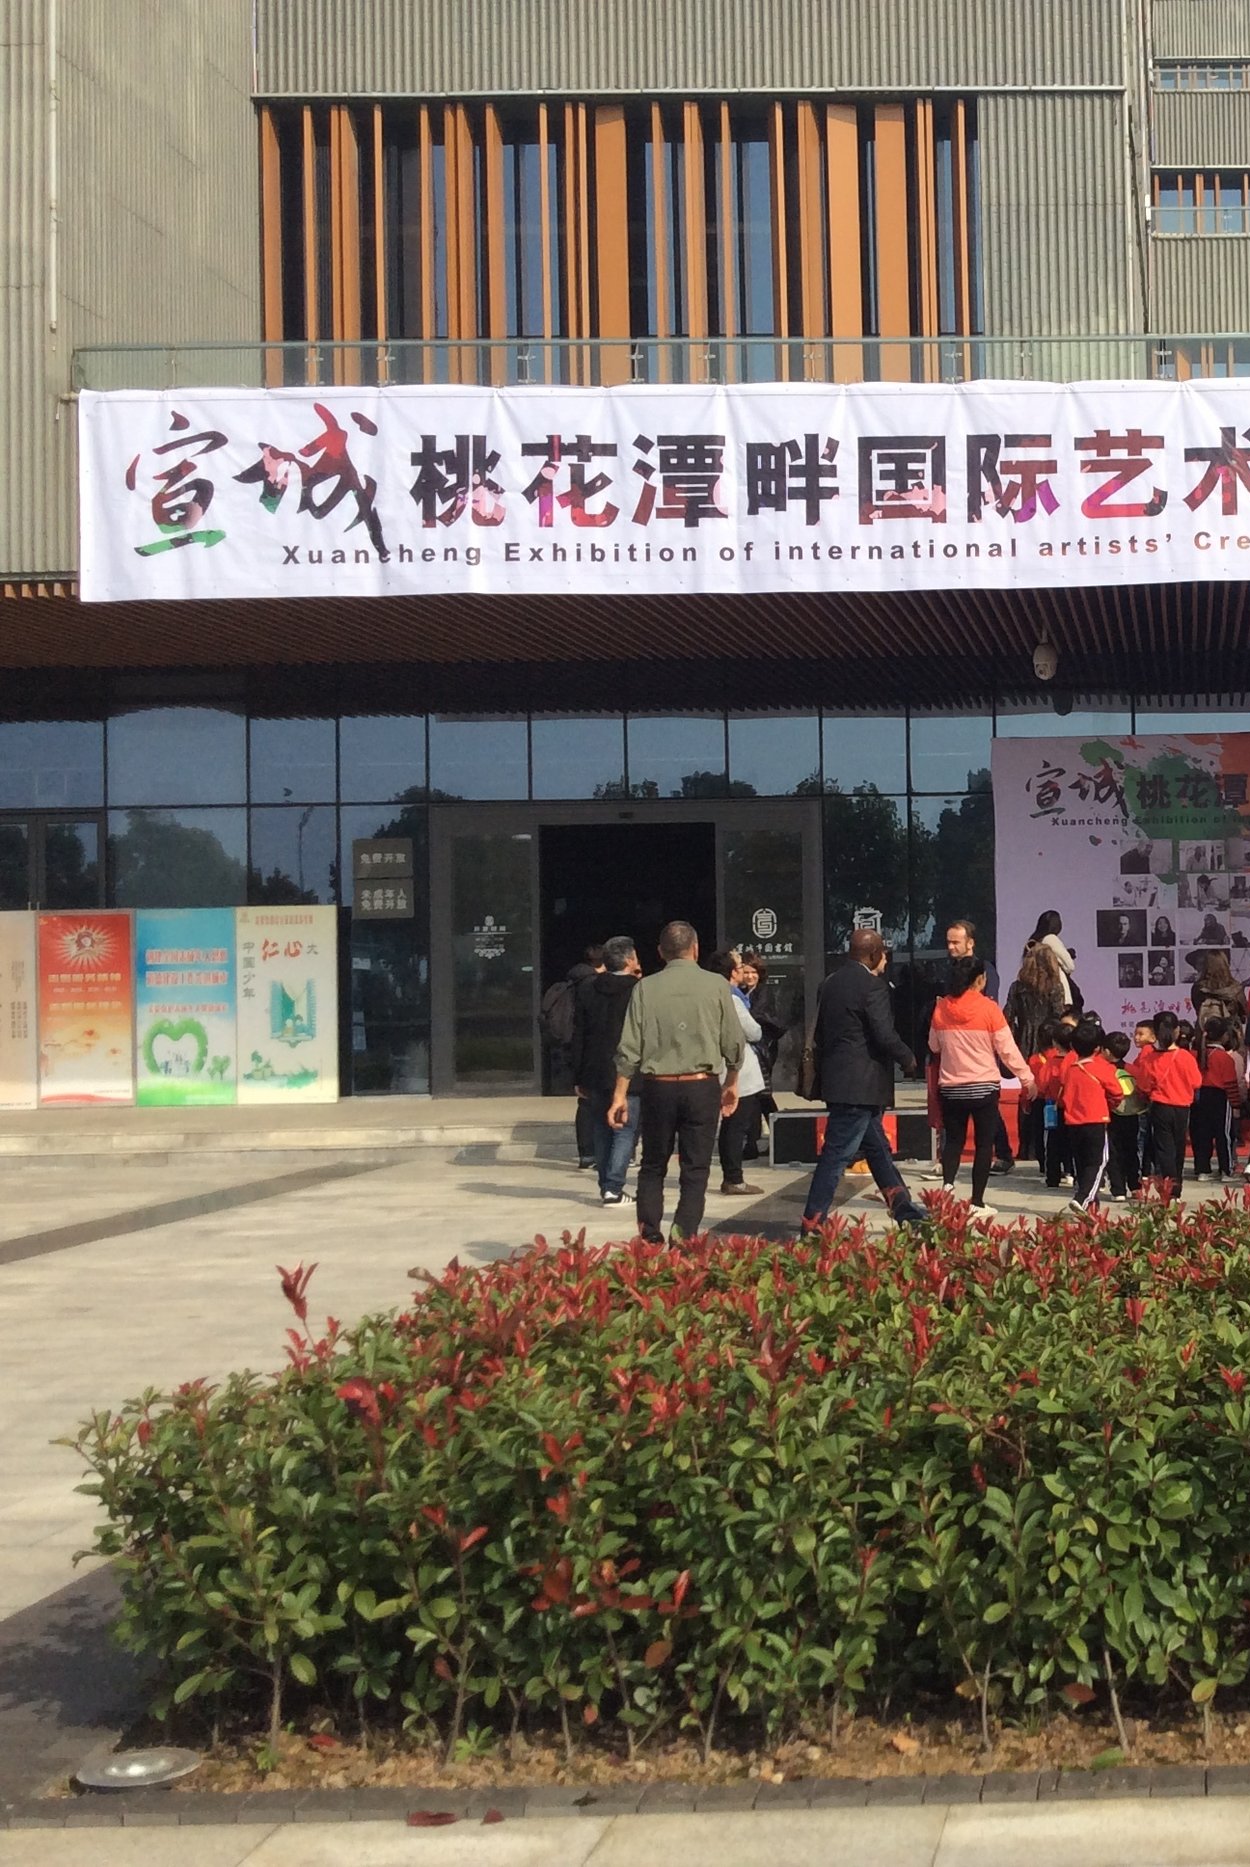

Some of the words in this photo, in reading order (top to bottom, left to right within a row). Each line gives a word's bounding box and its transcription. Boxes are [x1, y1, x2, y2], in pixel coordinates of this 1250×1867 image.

[282, 543, 481, 567] Xuancheng
[504, 543, 697, 562] Exhibition
[719, 541, 753, 561] of
[774, 537, 1017, 560] international
[1052, 814, 1128, 828] Xuancheng
[1132, 814, 1207, 825] Ehibition
[360, 852, 407, 865] 免费开放
[360, 888, 408, 900] 未成年人
[360, 899, 408, 911] 免费开放
